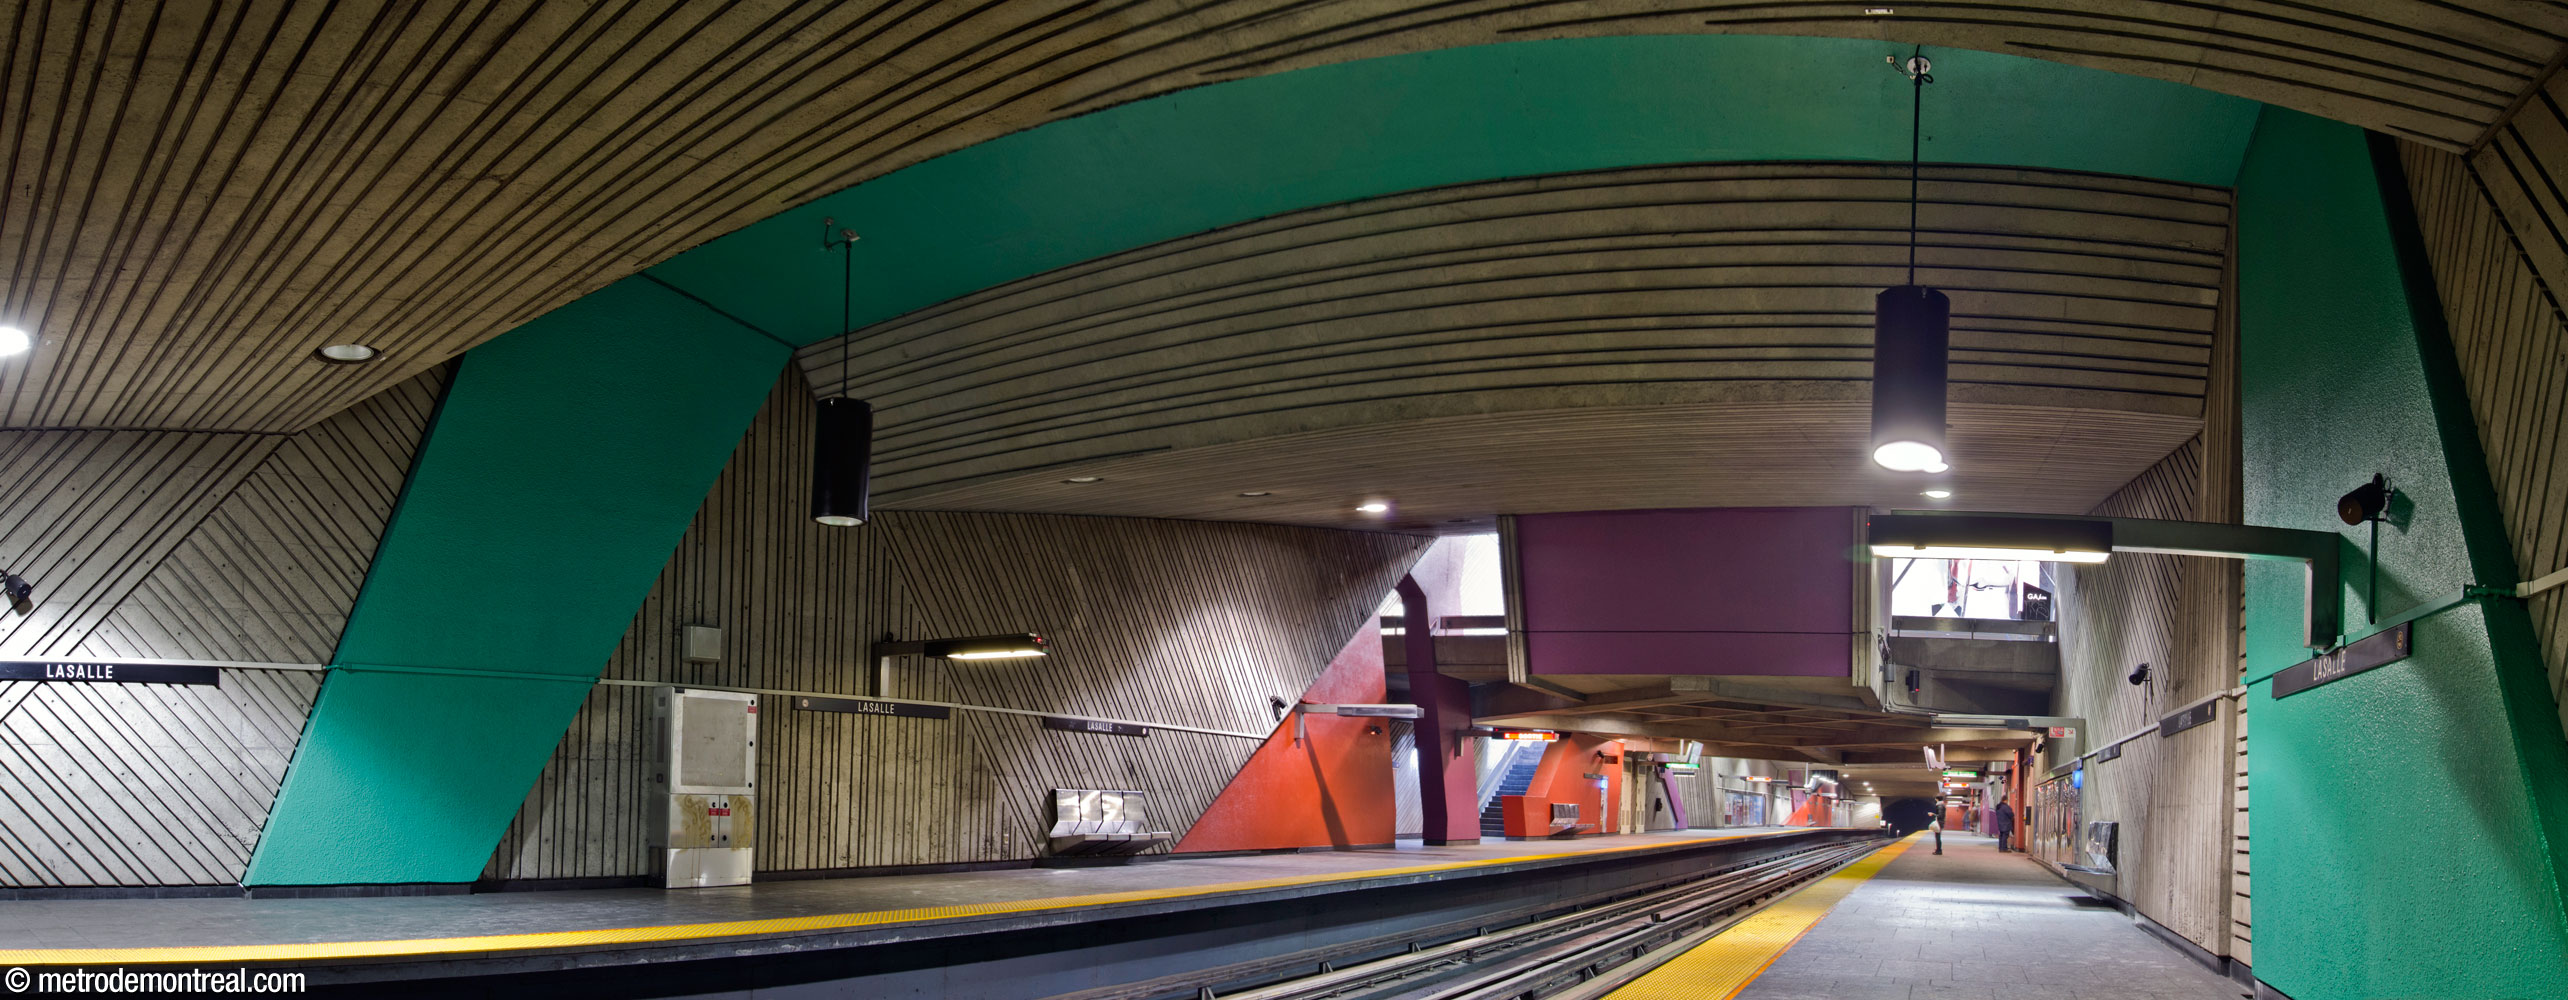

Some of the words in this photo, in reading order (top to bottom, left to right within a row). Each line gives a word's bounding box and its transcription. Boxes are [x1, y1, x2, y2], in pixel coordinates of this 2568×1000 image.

[46, 664, 113, 679] LASALLE
[2313, 650, 2346, 681] LASALLE
[857, 701, 895, 715] LASALLE
[1087, 721, 1113, 732] LASALLE
